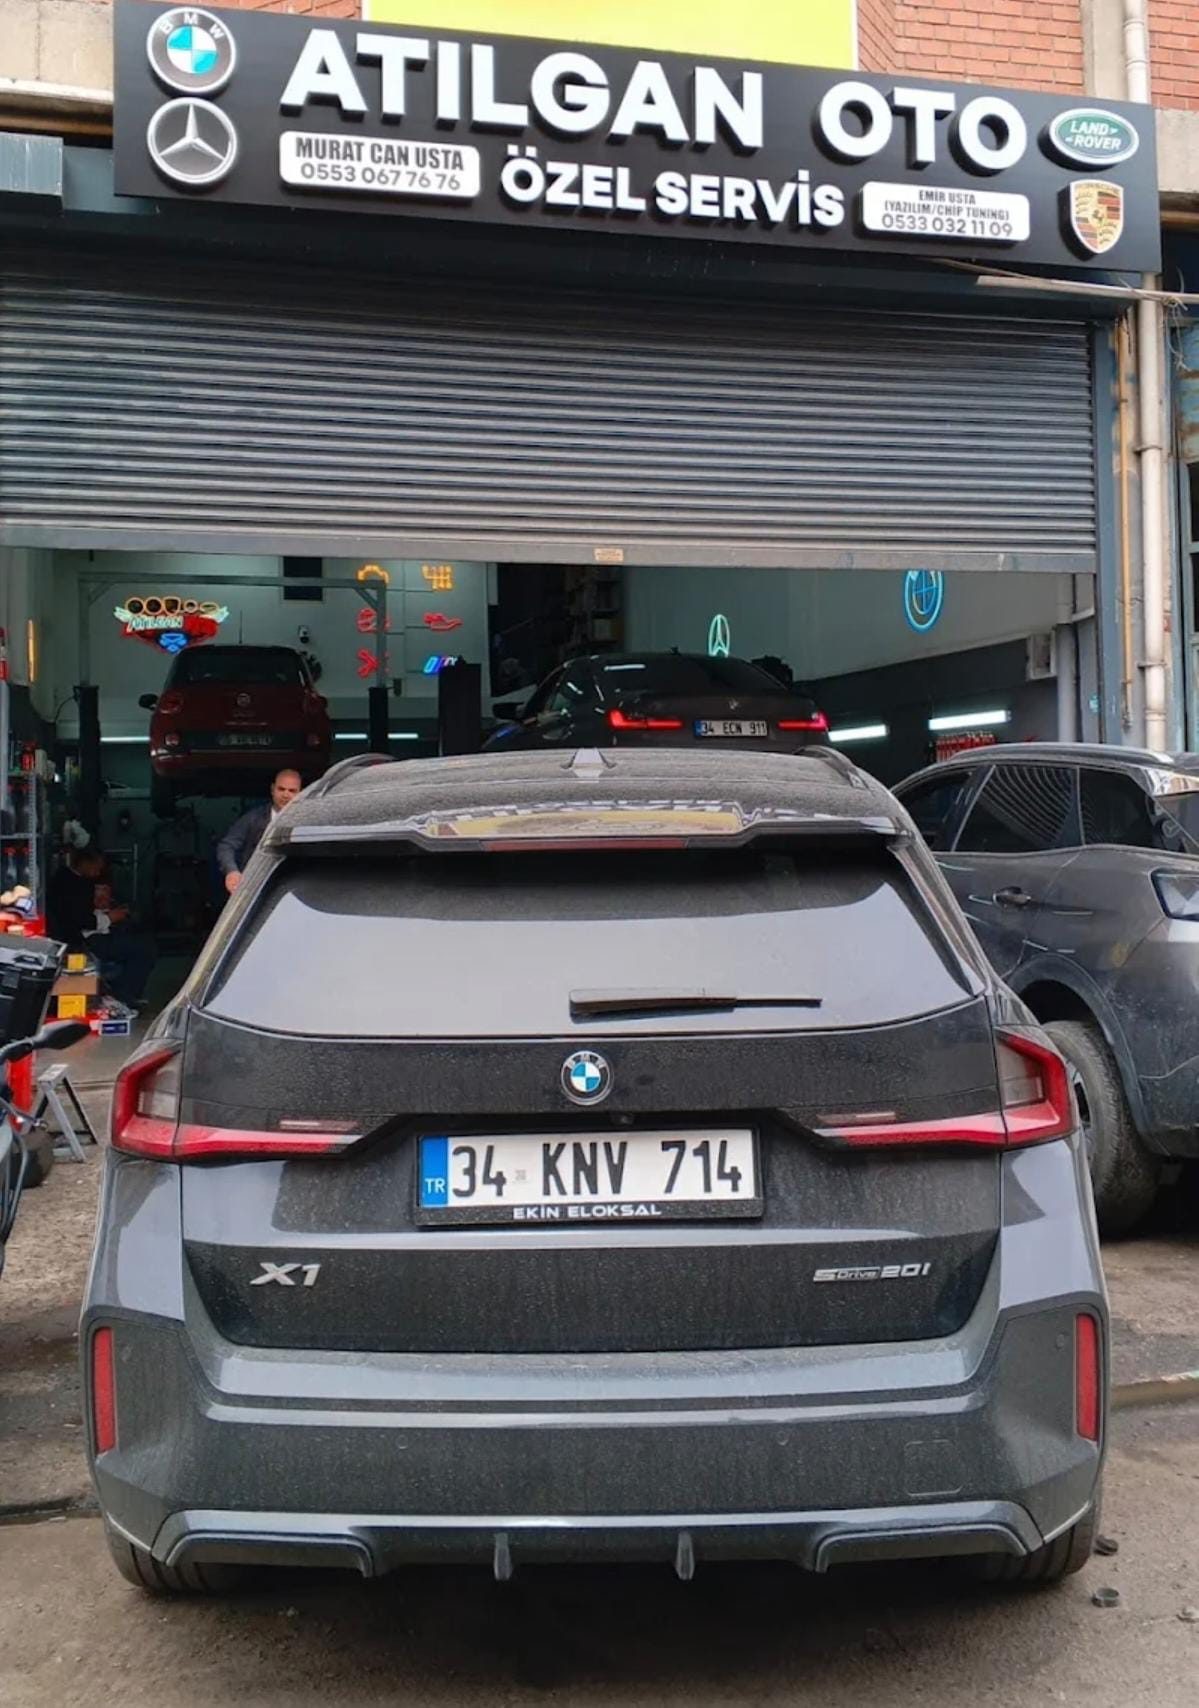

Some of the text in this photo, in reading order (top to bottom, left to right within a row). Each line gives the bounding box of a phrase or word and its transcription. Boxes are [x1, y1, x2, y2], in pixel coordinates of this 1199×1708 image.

[160, 12, 225, 40] BMW
[280, 28, 1028, 170] ATILGAN OTO
[1070, 120, 1110, 136] LAND
[296, 137, 464, 171] MURAT CAN USTA
[1073, 134, 1122, 150] ROVER
[301, 162, 461, 191] 0553 067 76 76
[501, 145, 845, 227] ÖZEL SERVİS
[948, 192, 976, 205] USTA
[881, 213, 1013, 237] 0533 032 11 09
[425, 1140, 742, 1198] TR 34 KNV 714
[513, 1202, 662, 1220] EKİN ELOKSAL
[249, 1262, 322, 1287] X1
